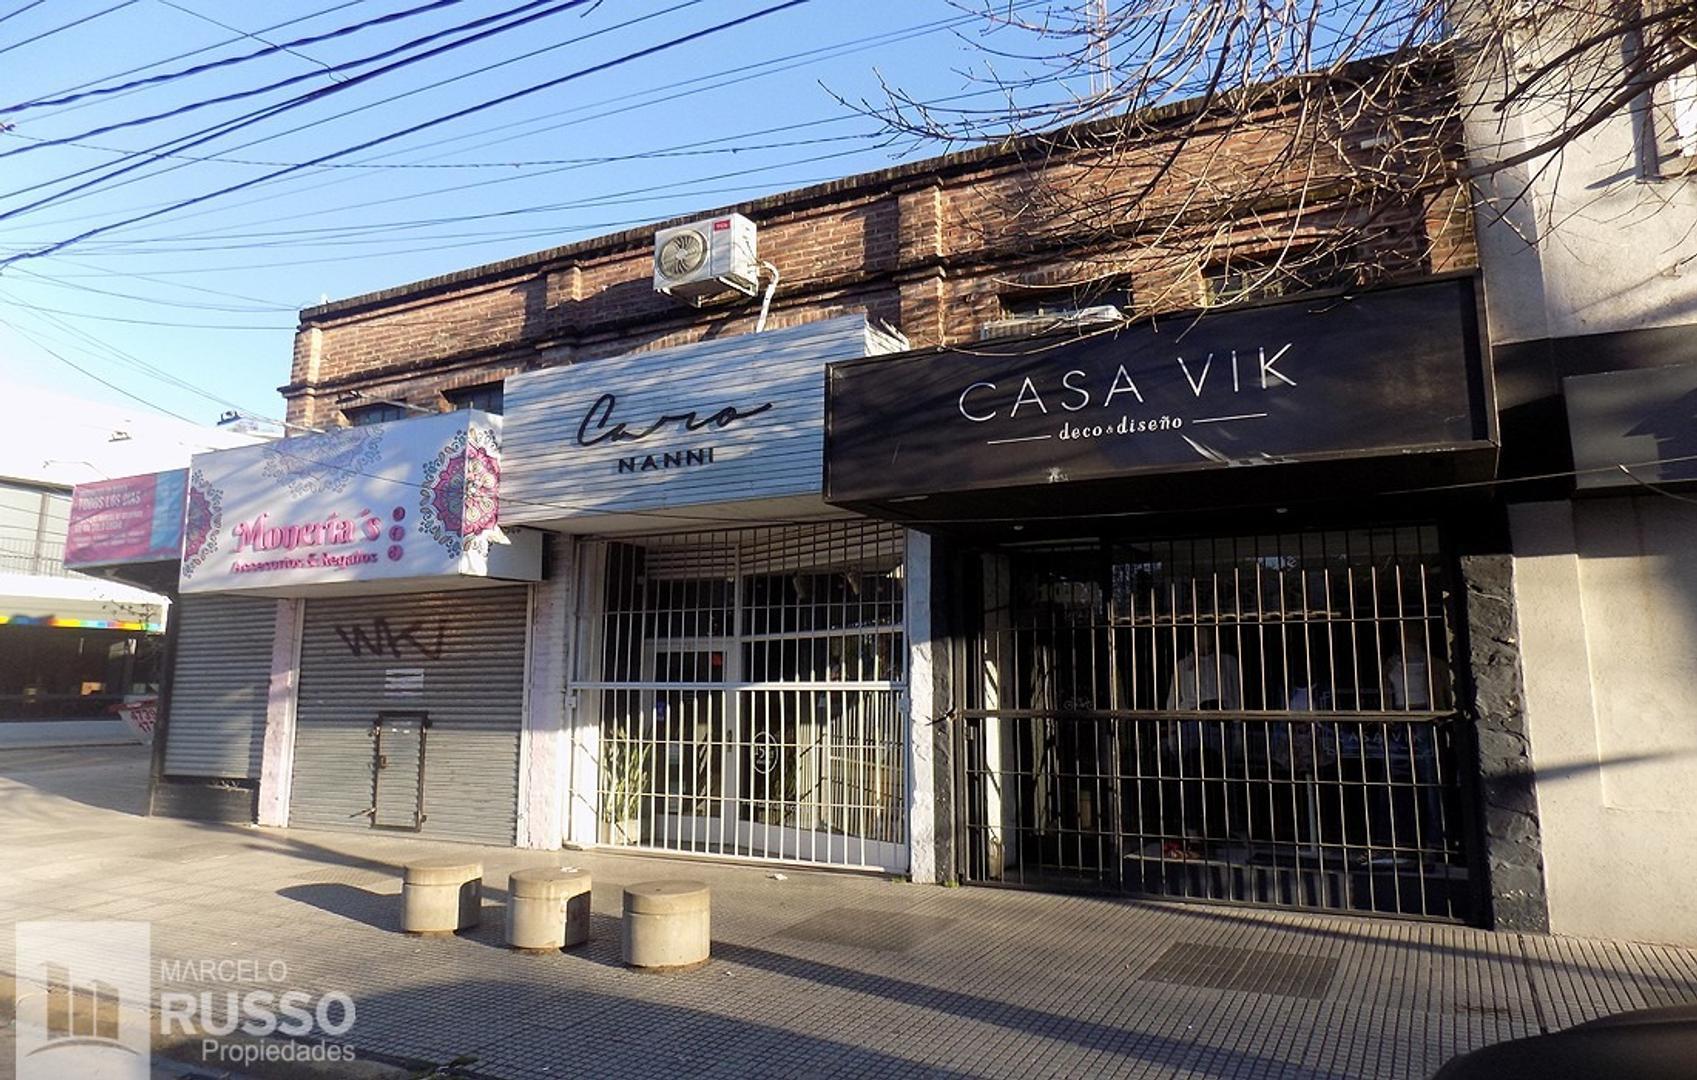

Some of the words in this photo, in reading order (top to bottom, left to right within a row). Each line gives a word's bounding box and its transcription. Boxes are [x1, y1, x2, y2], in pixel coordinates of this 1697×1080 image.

[959, 364, 1144, 422] CASA
[1177, 343, 1297, 397] VIK
[577, 393, 773, 447] Caro
[1059, 422, 1102, 440] deco
[1117, 415, 1182, 434] diseño
[618, 447, 715, 474] NANNI
